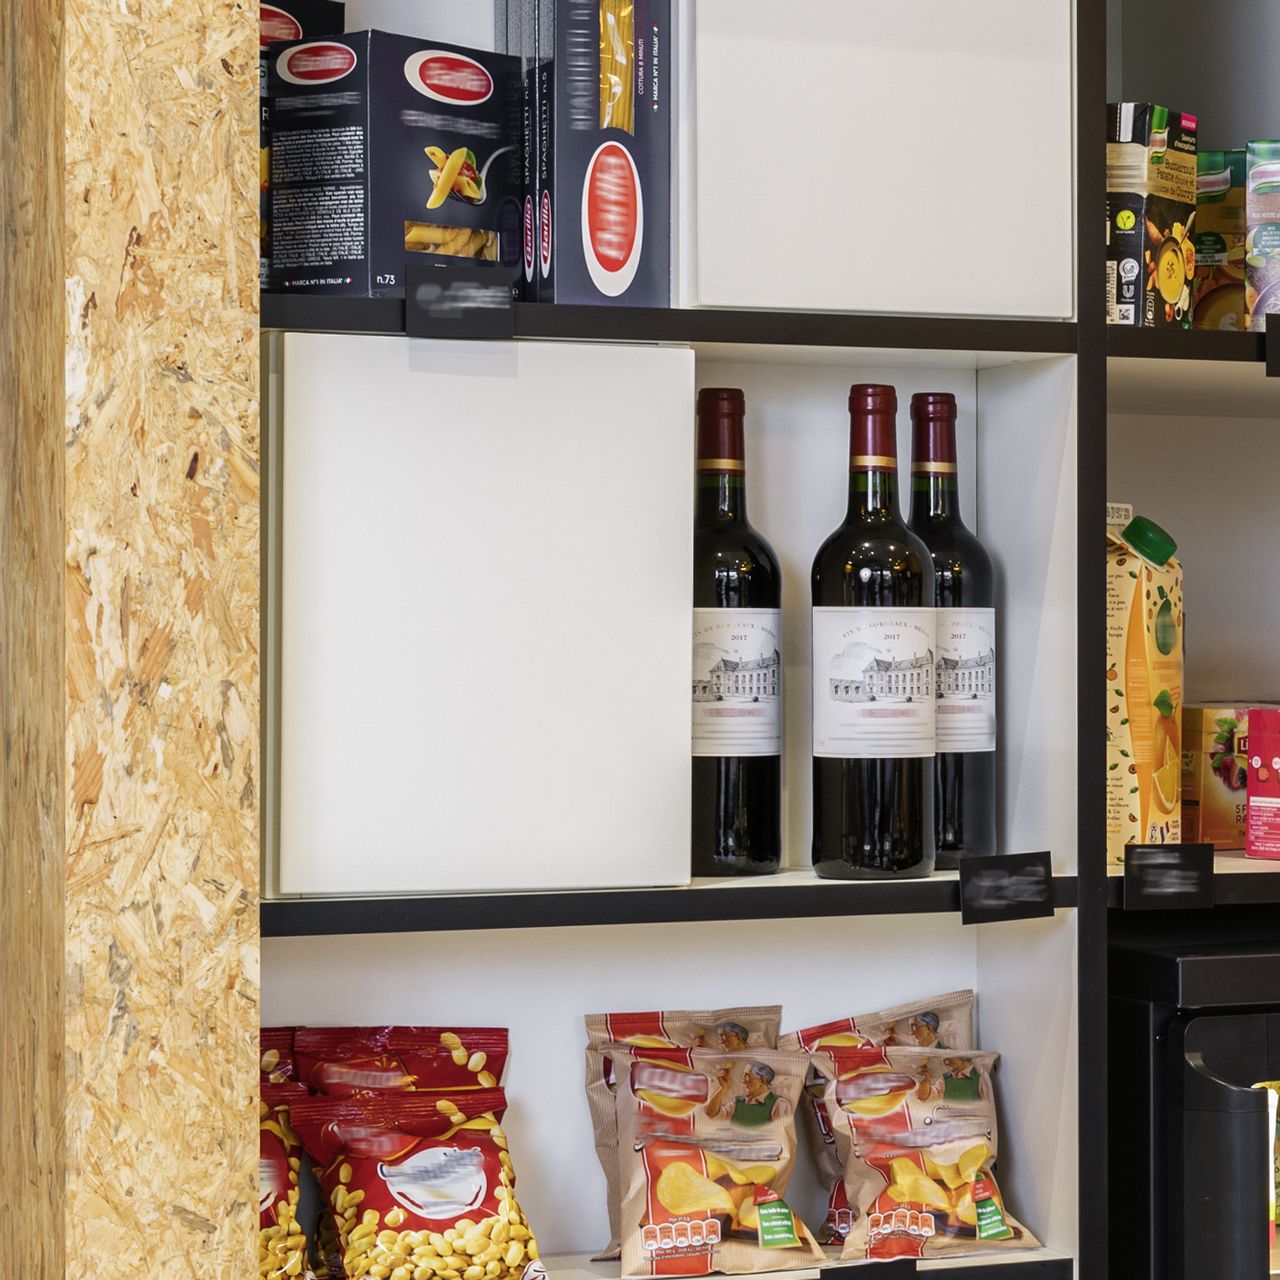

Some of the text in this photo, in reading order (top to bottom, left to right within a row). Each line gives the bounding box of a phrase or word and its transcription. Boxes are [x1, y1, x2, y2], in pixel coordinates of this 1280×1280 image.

[376, 274, 396, 286] n.73
[730, 634, 748, 642] 2017
[883, 633, 901, 641] 2017
[950, 632, 967, 640] 2017
